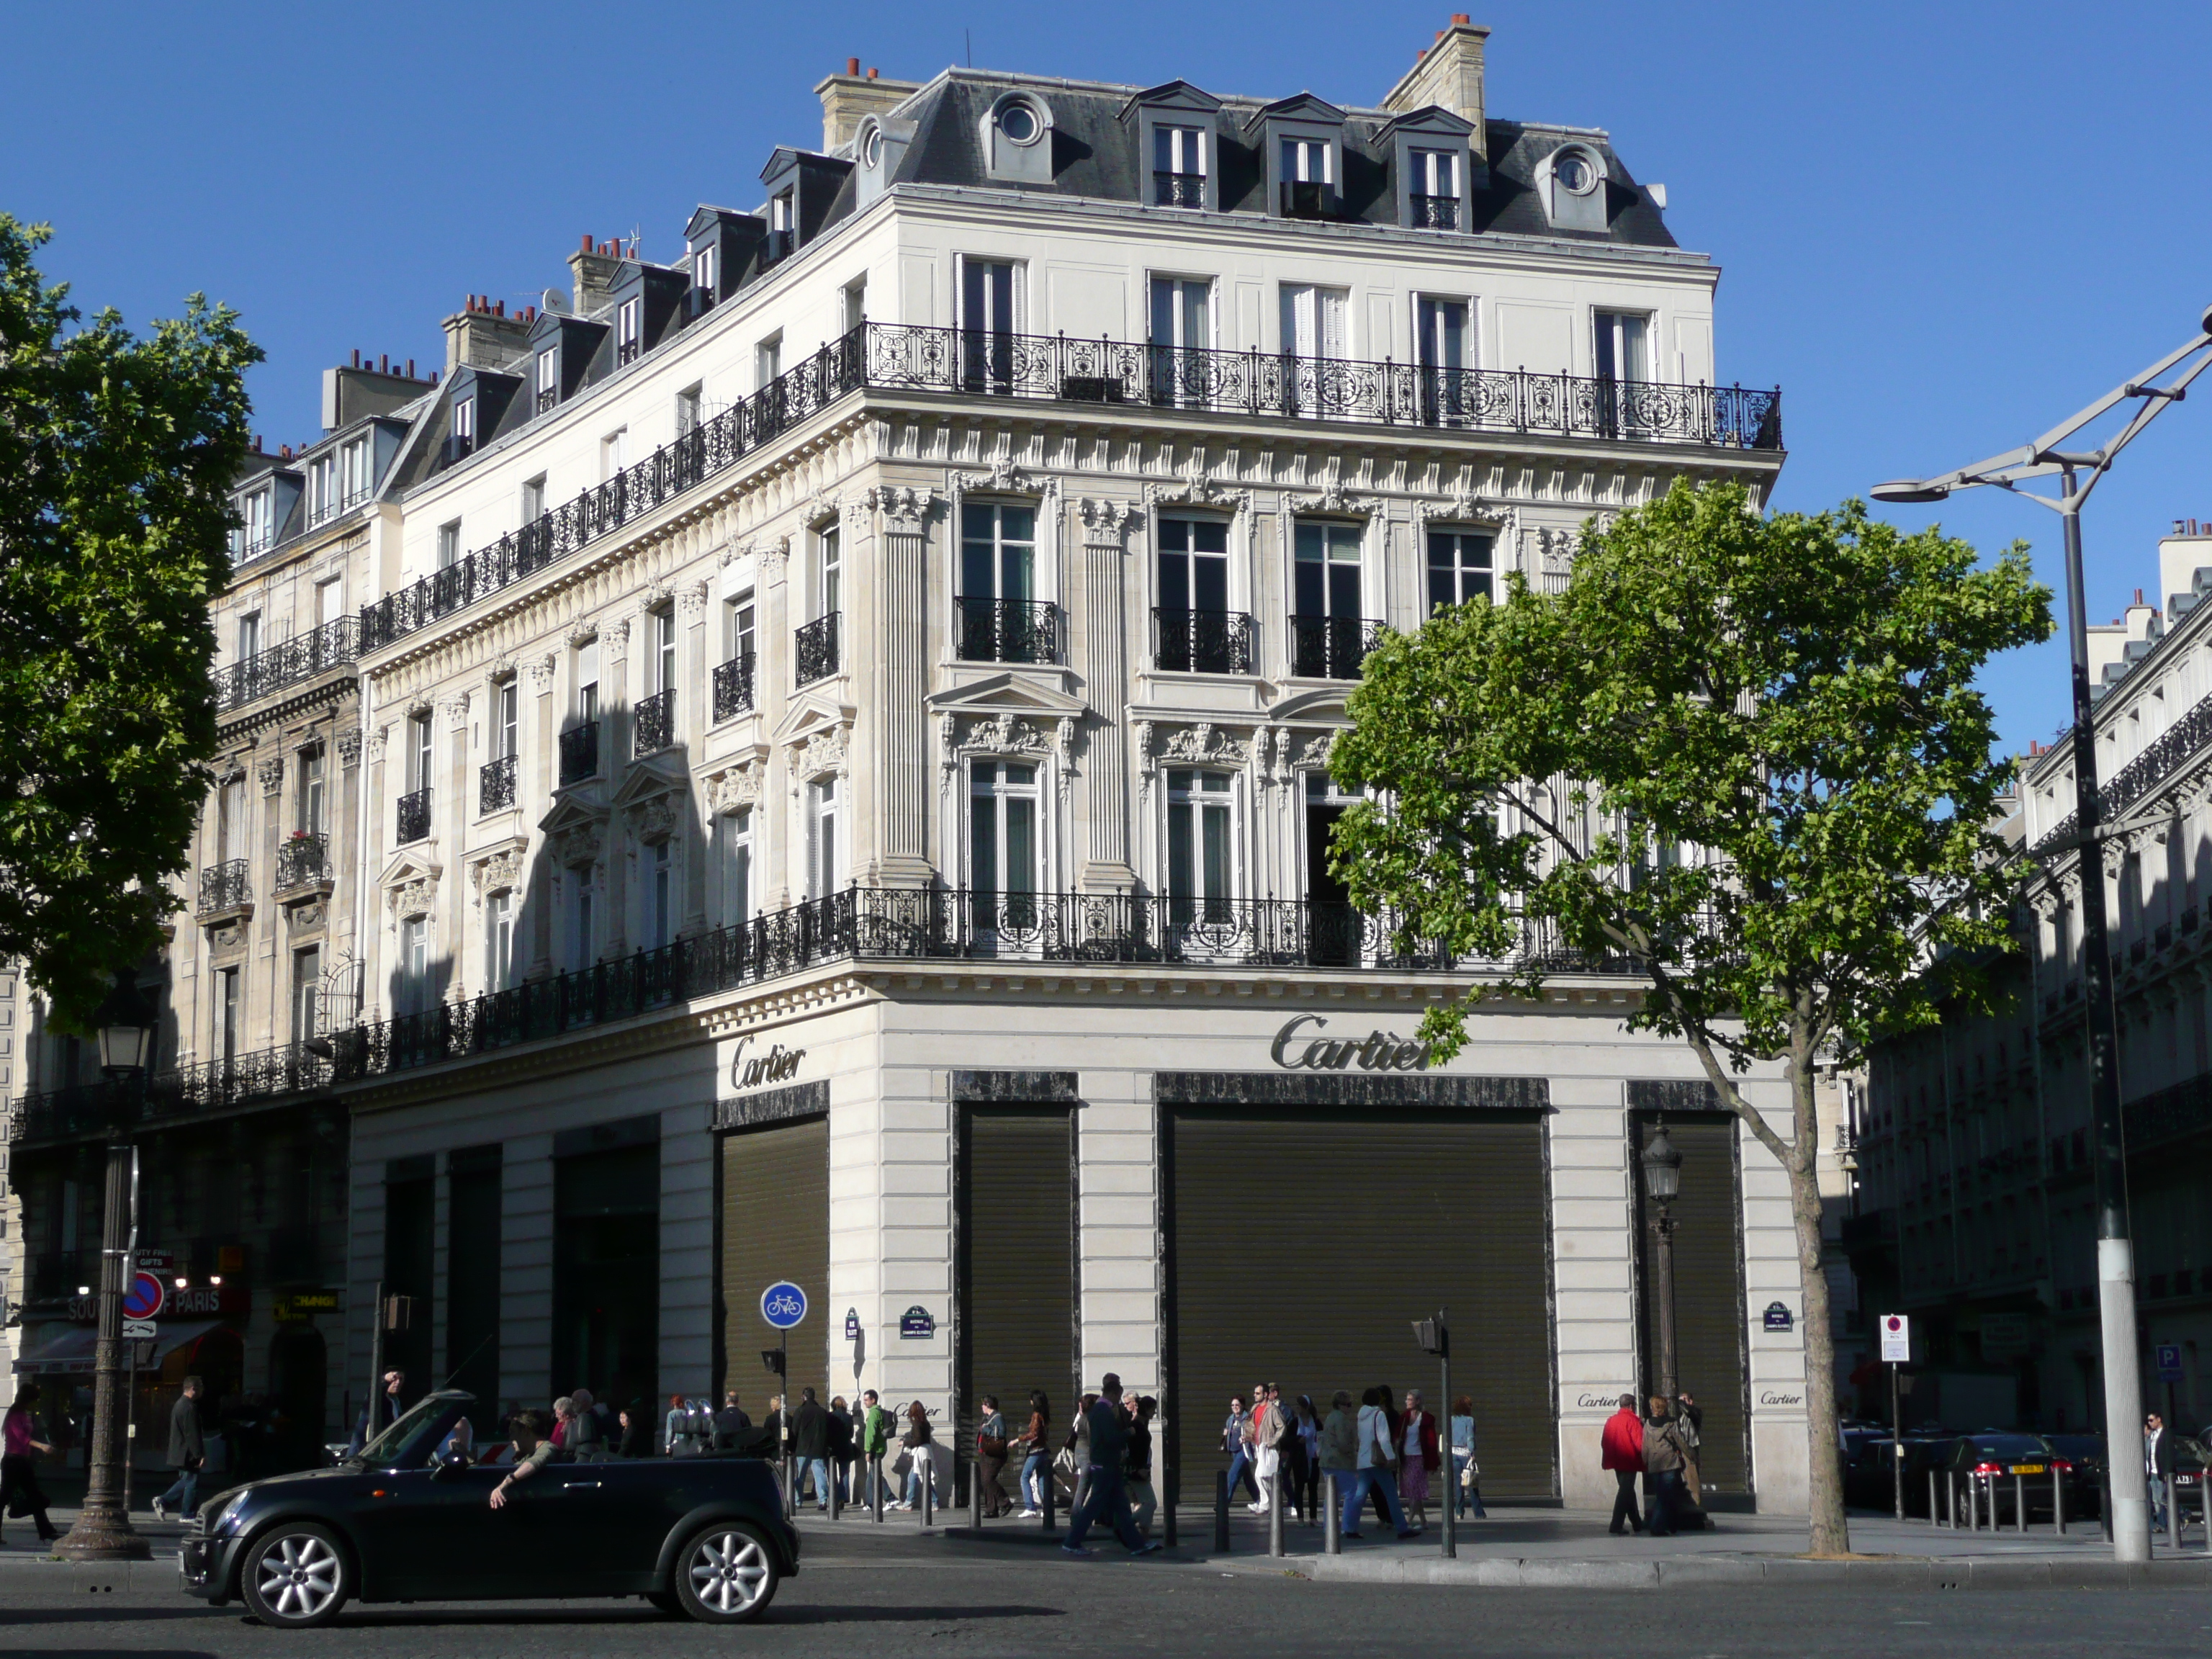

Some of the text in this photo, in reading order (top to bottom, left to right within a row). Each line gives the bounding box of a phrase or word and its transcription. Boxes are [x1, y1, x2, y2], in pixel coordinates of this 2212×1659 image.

[1271, 1013, 1432, 1071] Cartier
[730, 1033, 806, 1090] Cartier
[176, 1290, 220, 1313] PARIS
[293, 1295, 338, 1308] CHANGE
[2164, 1349, 2174, 1365] P
[1578, 1393, 1619, 1407] Cartier
[1761, 1390, 1802, 1406] Cartier
[894, 1402, 941, 1416] Caier
